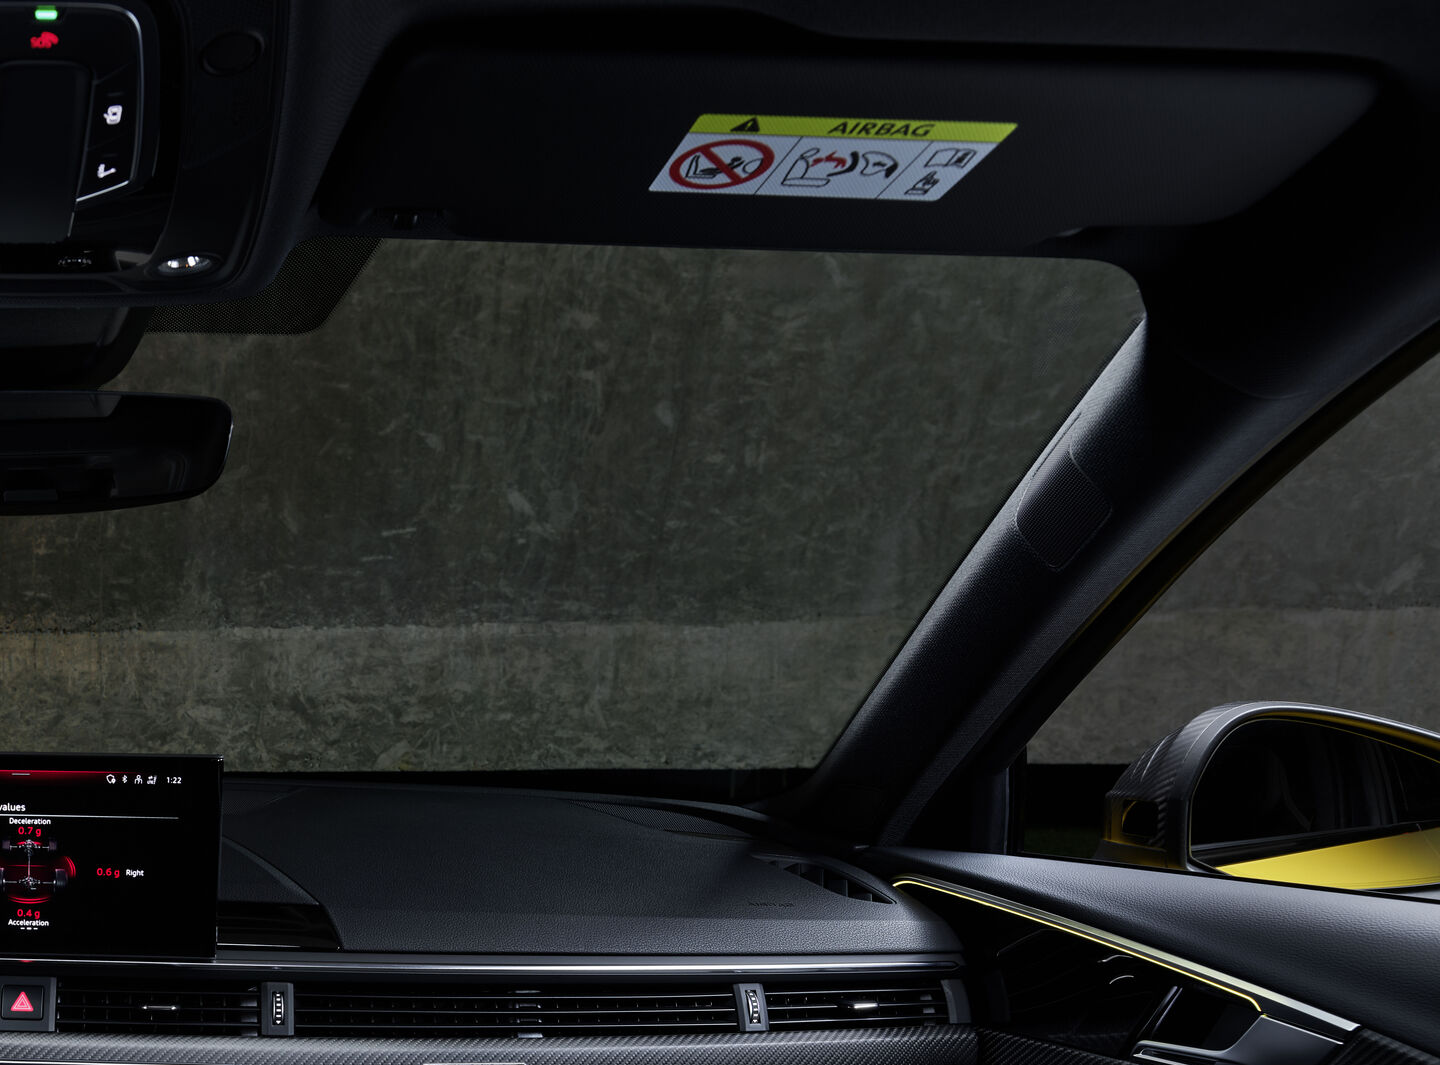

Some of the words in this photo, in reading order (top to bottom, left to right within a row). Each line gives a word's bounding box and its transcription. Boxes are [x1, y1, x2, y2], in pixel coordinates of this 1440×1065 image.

[827, 121, 936, 137] AIRBAG
[166, 776, 182, 784] 1:22
[8, 817, 51, 826] Deceleration
[18, 827, 32, 836] 0.7
[34, 828, 42, 837] g
[96, 868, 111, 877] 0.6
[113, 869, 120, 878] g
[125, 869, 145, 878] Right
[17, 909, 31, 918] 0.4
[33, 910, 41, 919] g
[8, 918, 49, 927] Acceleration
